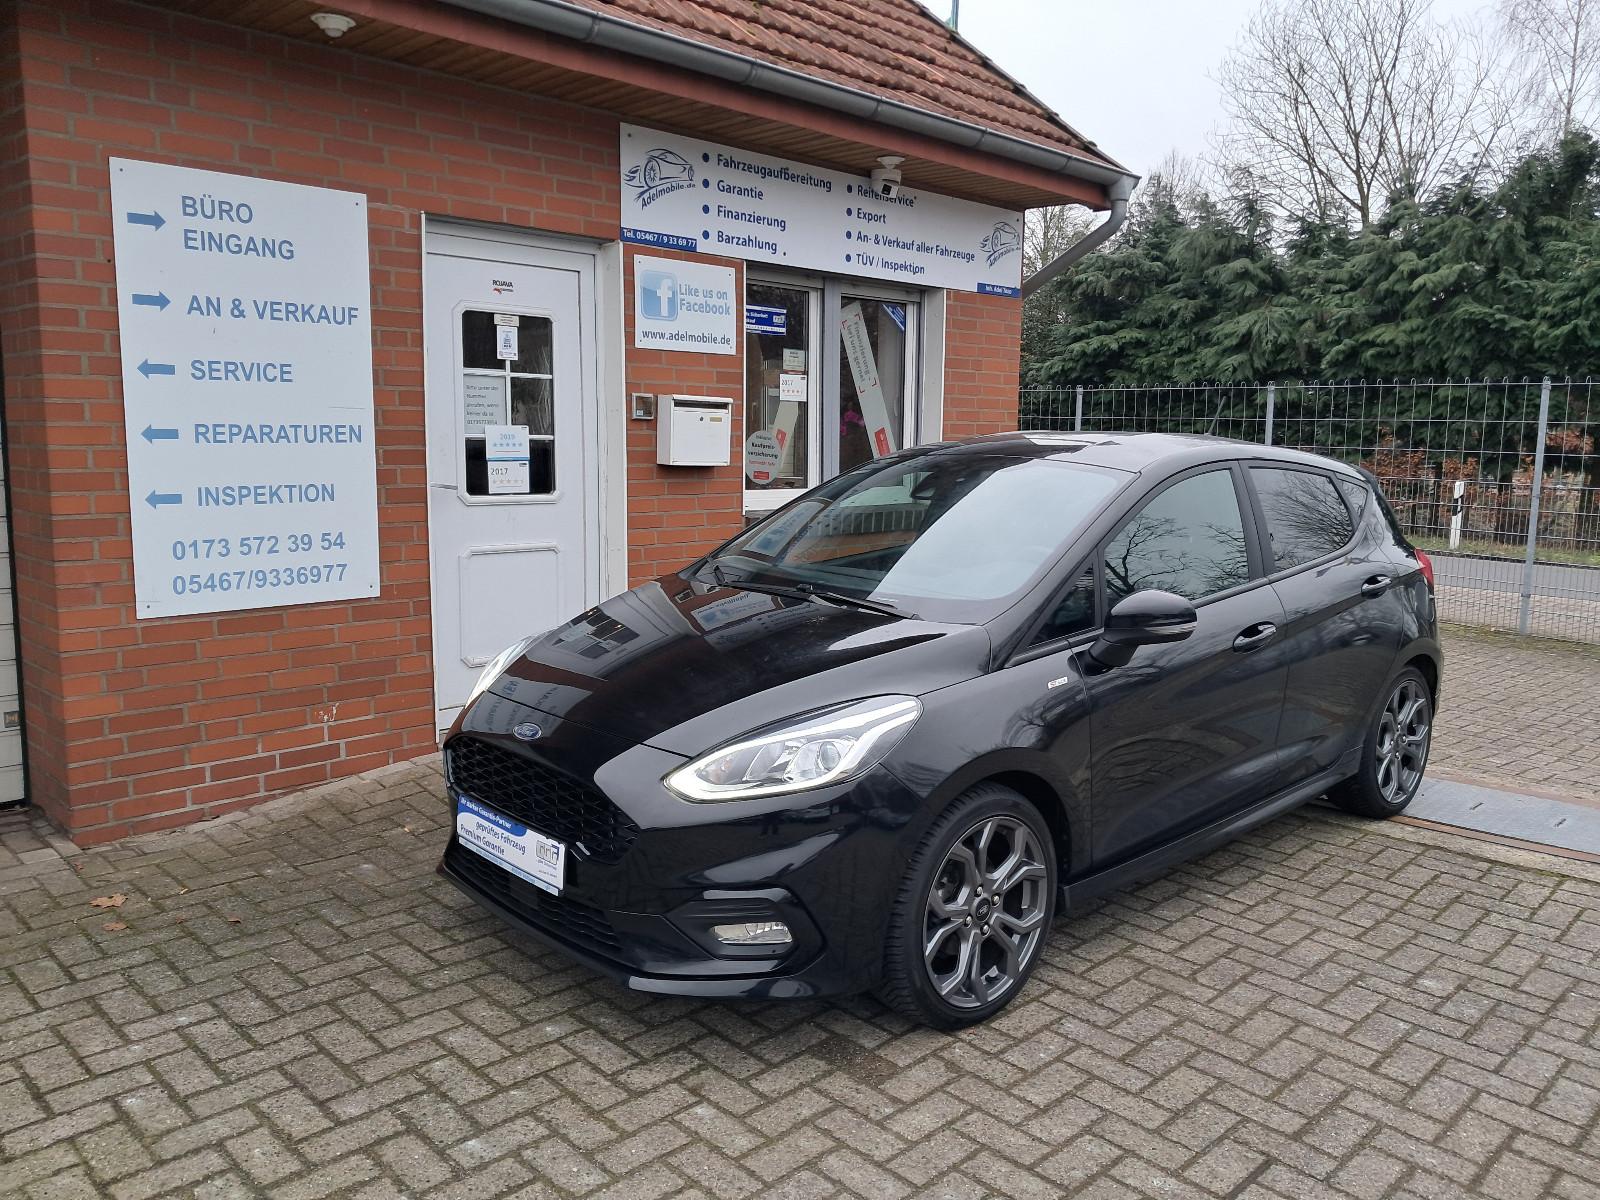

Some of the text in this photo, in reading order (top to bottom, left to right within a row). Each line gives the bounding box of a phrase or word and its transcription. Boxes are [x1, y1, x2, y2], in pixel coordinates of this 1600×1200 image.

[717, 153, 832, 192] Fahrzeugaufbereitung
[641, 183, 696, 211] Adelmobile.de
[717, 179, 764, 200] Garantie
[181, 194, 254, 225] BÜRO
[717, 205, 786, 232] Finanzierung
[857, 208, 886, 224] Export
[183, 229, 295, 260] EINGANG
[623, 229, 635, 238] Tel.
[636, 231, 658, 242] 05467
[662, 236, 668, 244] 9
[668, 236, 677, 245] 33
[678, 238, 687, 247] 69
[688, 239, 697, 248] 77
[717, 230, 778, 255] Barzahlung
[856, 230, 976, 263] An- & Verkauf aller Fahrzeuge
[856, 251, 875, 267] TÜV
[881, 258, 925, 275] Inspektion
[679, 284, 728, 301] Like us on
[187, 295, 360, 326] AN & VERKAUF
[680, 298, 731, 316] Facebook
[642, 330, 731, 345] www.adelmobile.de
[190, 359, 294, 383] SERVICE
[194, 423, 363, 444] REPARATUREN
[490, 468, 508, 476] 2017
[197, 483, 336, 507] INSPEKTION
[172, 531, 346, 561] 0173 572 39 54
[172, 563, 348, 595] 05467/9336977
[460, 823, 505, 856] Premium Garantie
[475, 821, 500, 840] geprüftes
[501, 832, 526, 855] Fahrzeug
